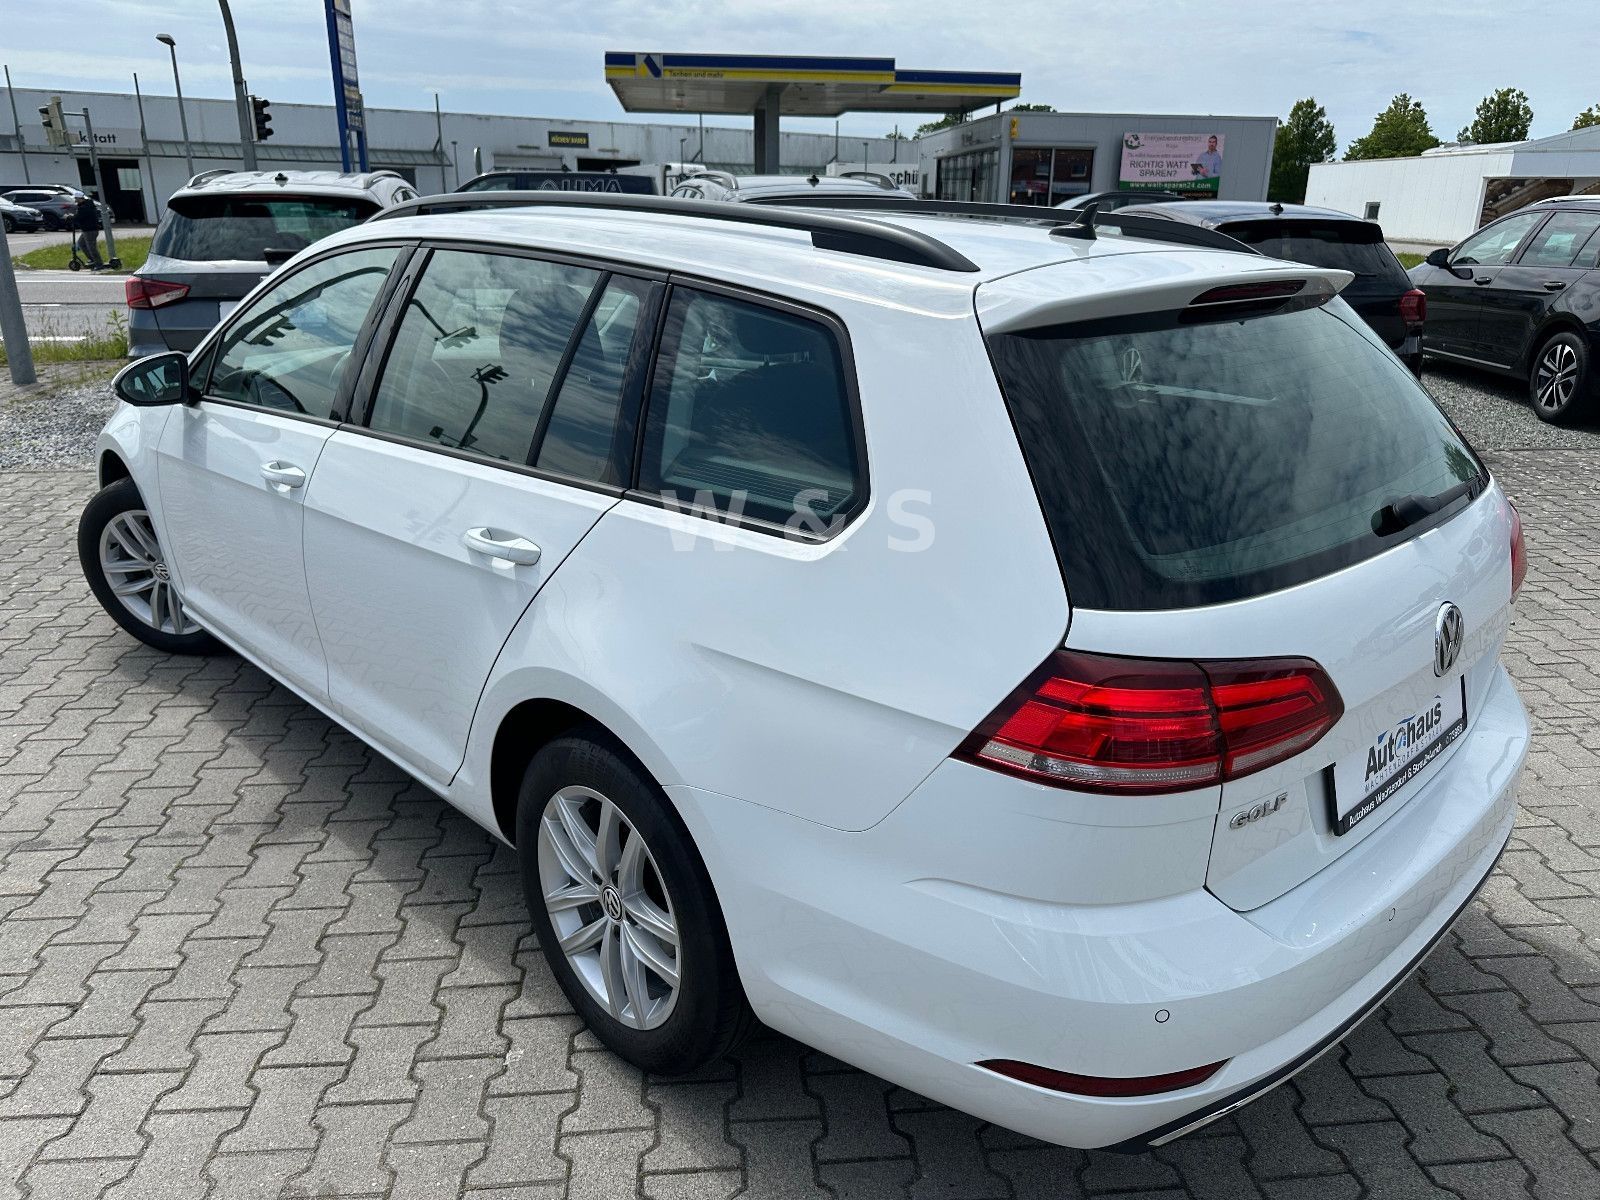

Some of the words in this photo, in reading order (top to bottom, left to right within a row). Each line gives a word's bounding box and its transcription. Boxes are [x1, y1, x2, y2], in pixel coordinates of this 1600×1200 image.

[79, 130, 116, 143] ktatt
[1129, 160, 1164, 169] RICHTIG
[1165, 160, 1189, 169] WATT
[1139, 169, 1177, 177] SPAREN?
[1364, 702, 1442, 782] Autohaus
[1230, 792, 1288, 830] GOLF
